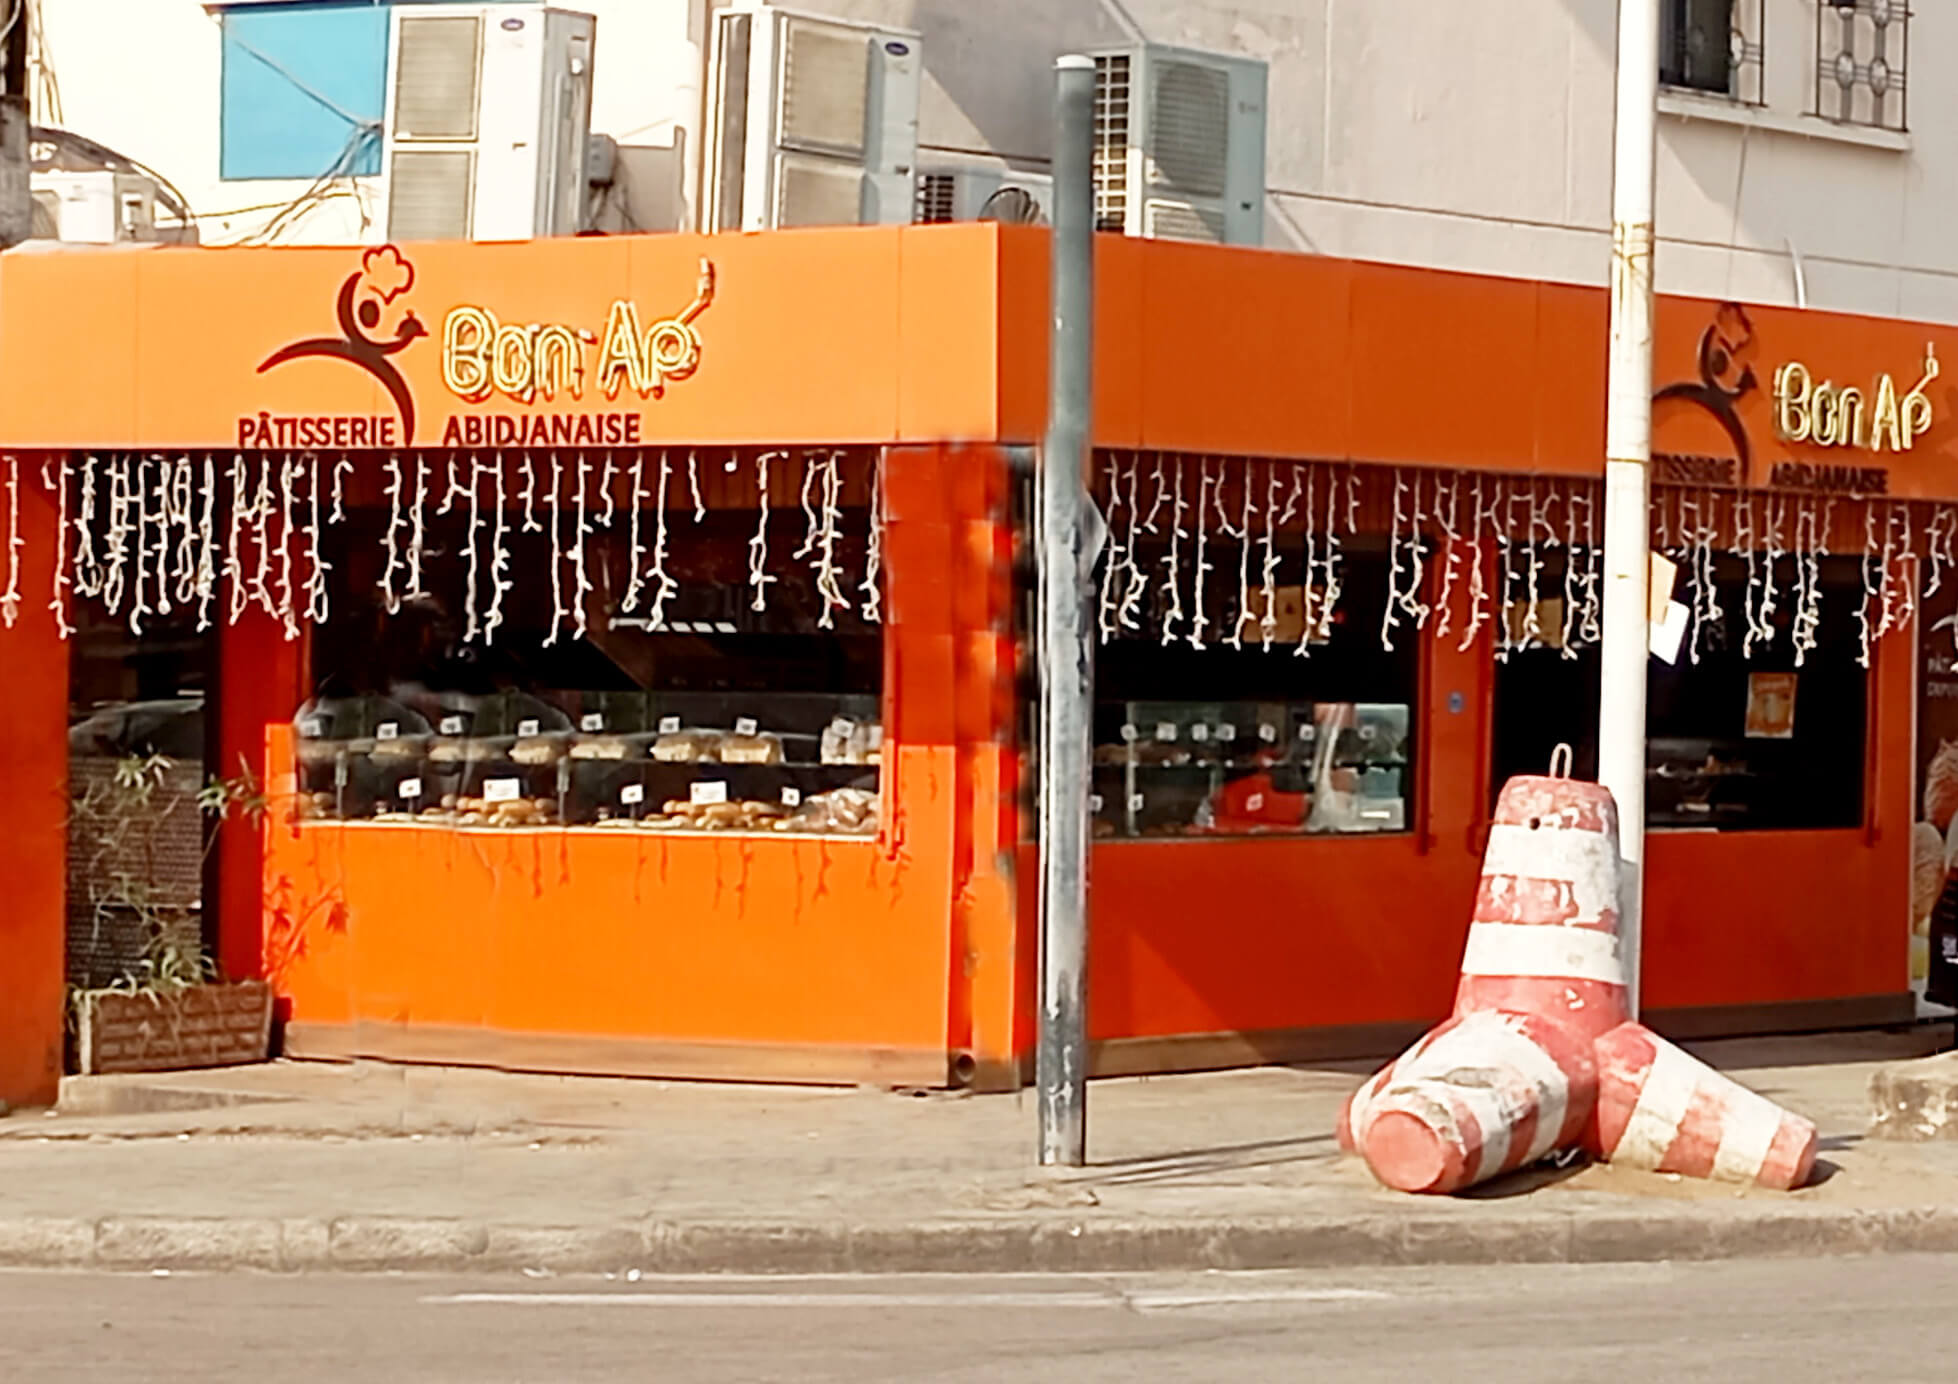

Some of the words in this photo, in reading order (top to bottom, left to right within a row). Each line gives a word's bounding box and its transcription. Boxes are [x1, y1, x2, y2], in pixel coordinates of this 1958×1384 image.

[442, 306, 583, 404] Bon
[239, 411, 395, 447] PÂTISSERIE
[443, 413, 641, 446] ABIDJANAISE
[1774, 362, 1863, 447] Bon
